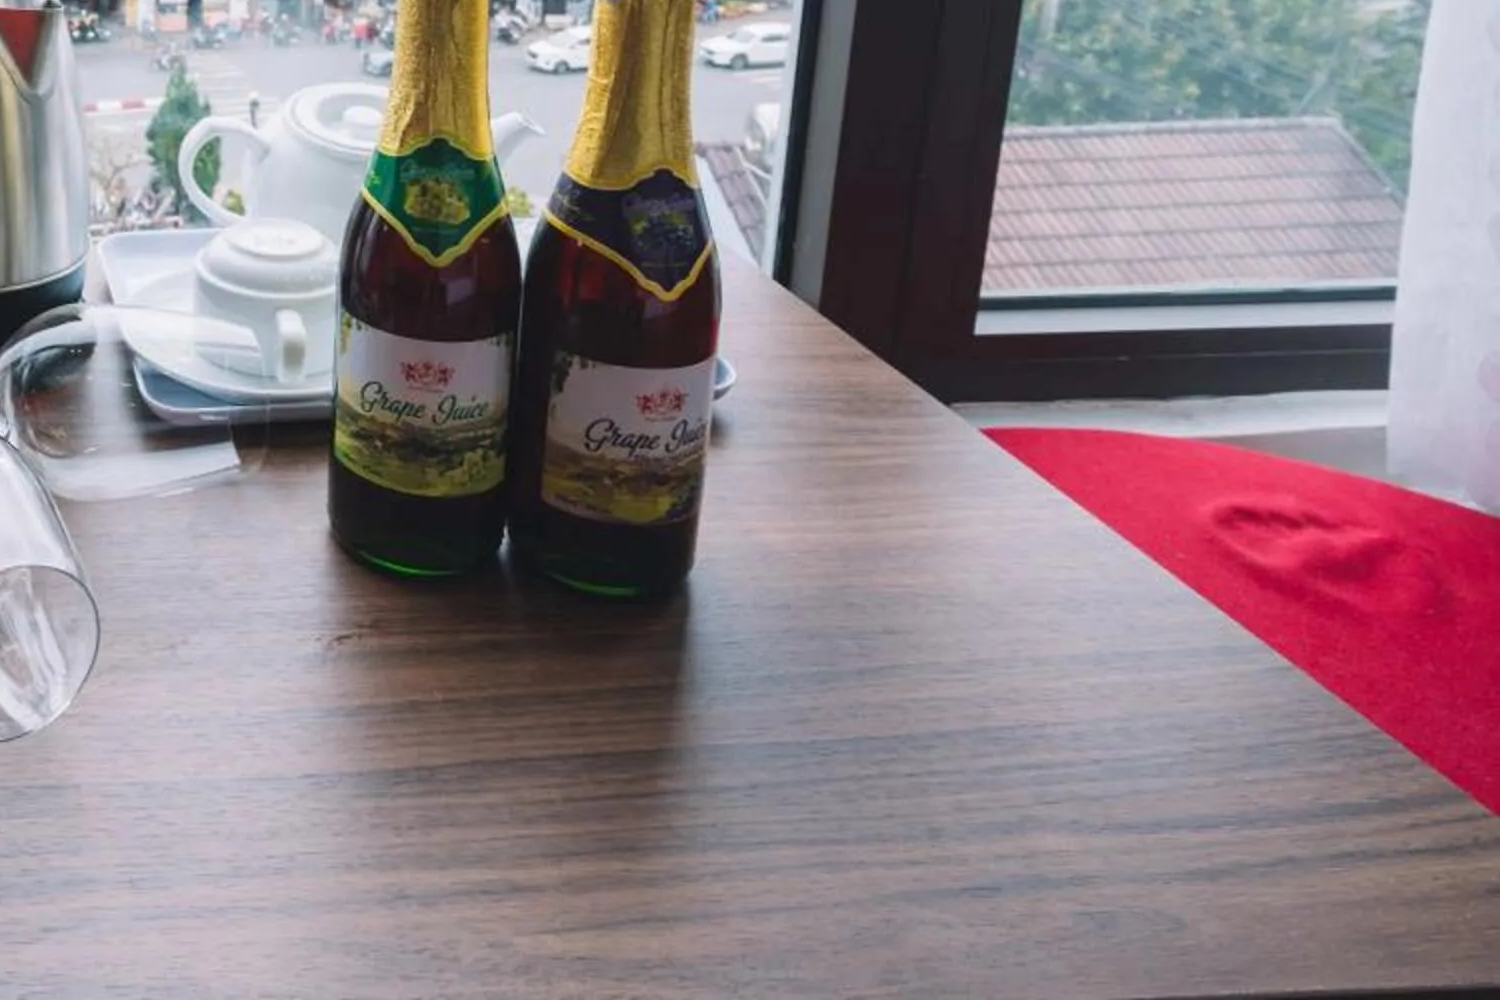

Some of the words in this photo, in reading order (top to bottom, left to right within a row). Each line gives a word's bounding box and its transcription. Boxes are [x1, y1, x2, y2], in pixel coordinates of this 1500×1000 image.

[360, 381, 426, 421] Grape
[432, 394, 489, 426] Juice
[584, 418, 660, 456] Grape
